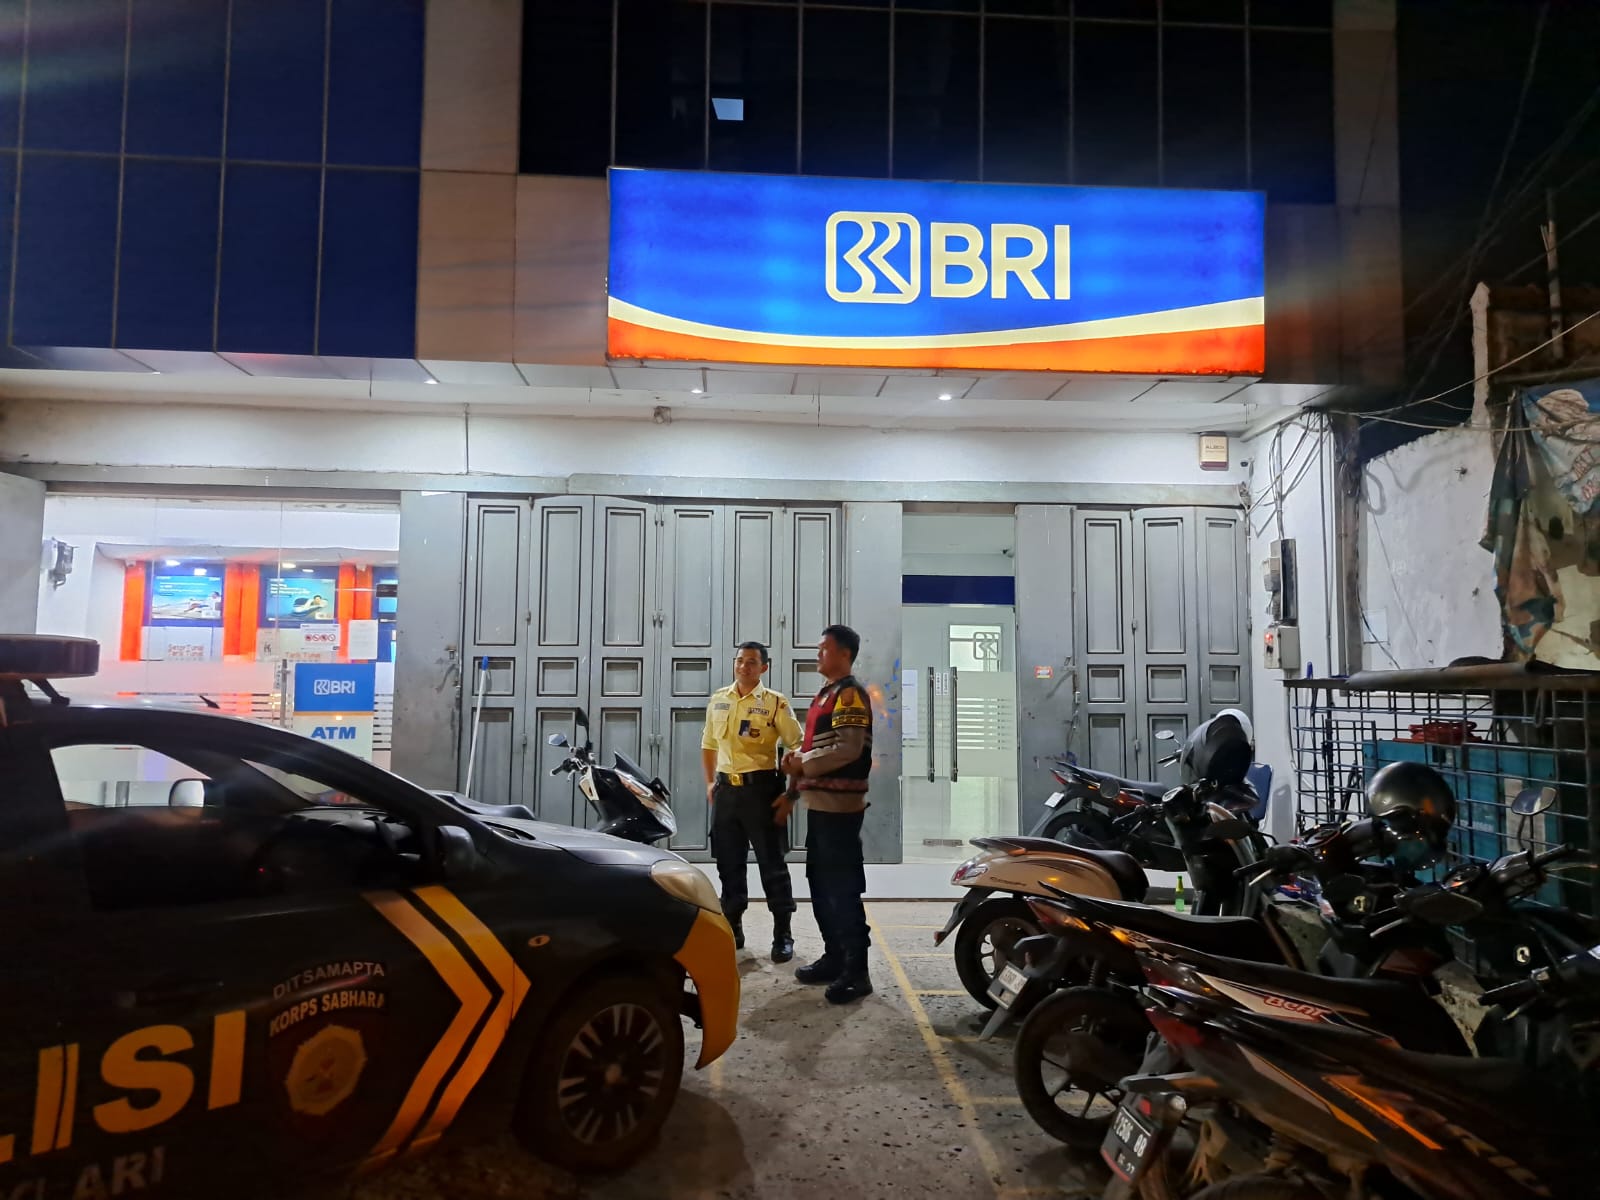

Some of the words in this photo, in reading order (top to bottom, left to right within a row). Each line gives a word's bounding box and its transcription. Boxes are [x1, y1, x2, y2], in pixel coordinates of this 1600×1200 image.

[930, 222, 1071, 301] BRI
[331, 680, 355, 694] BRI
[311, 726, 357, 740] ATM
[269, 997, 318, 1037] KORPS
[0, 1009, 247, 1166] ISI
